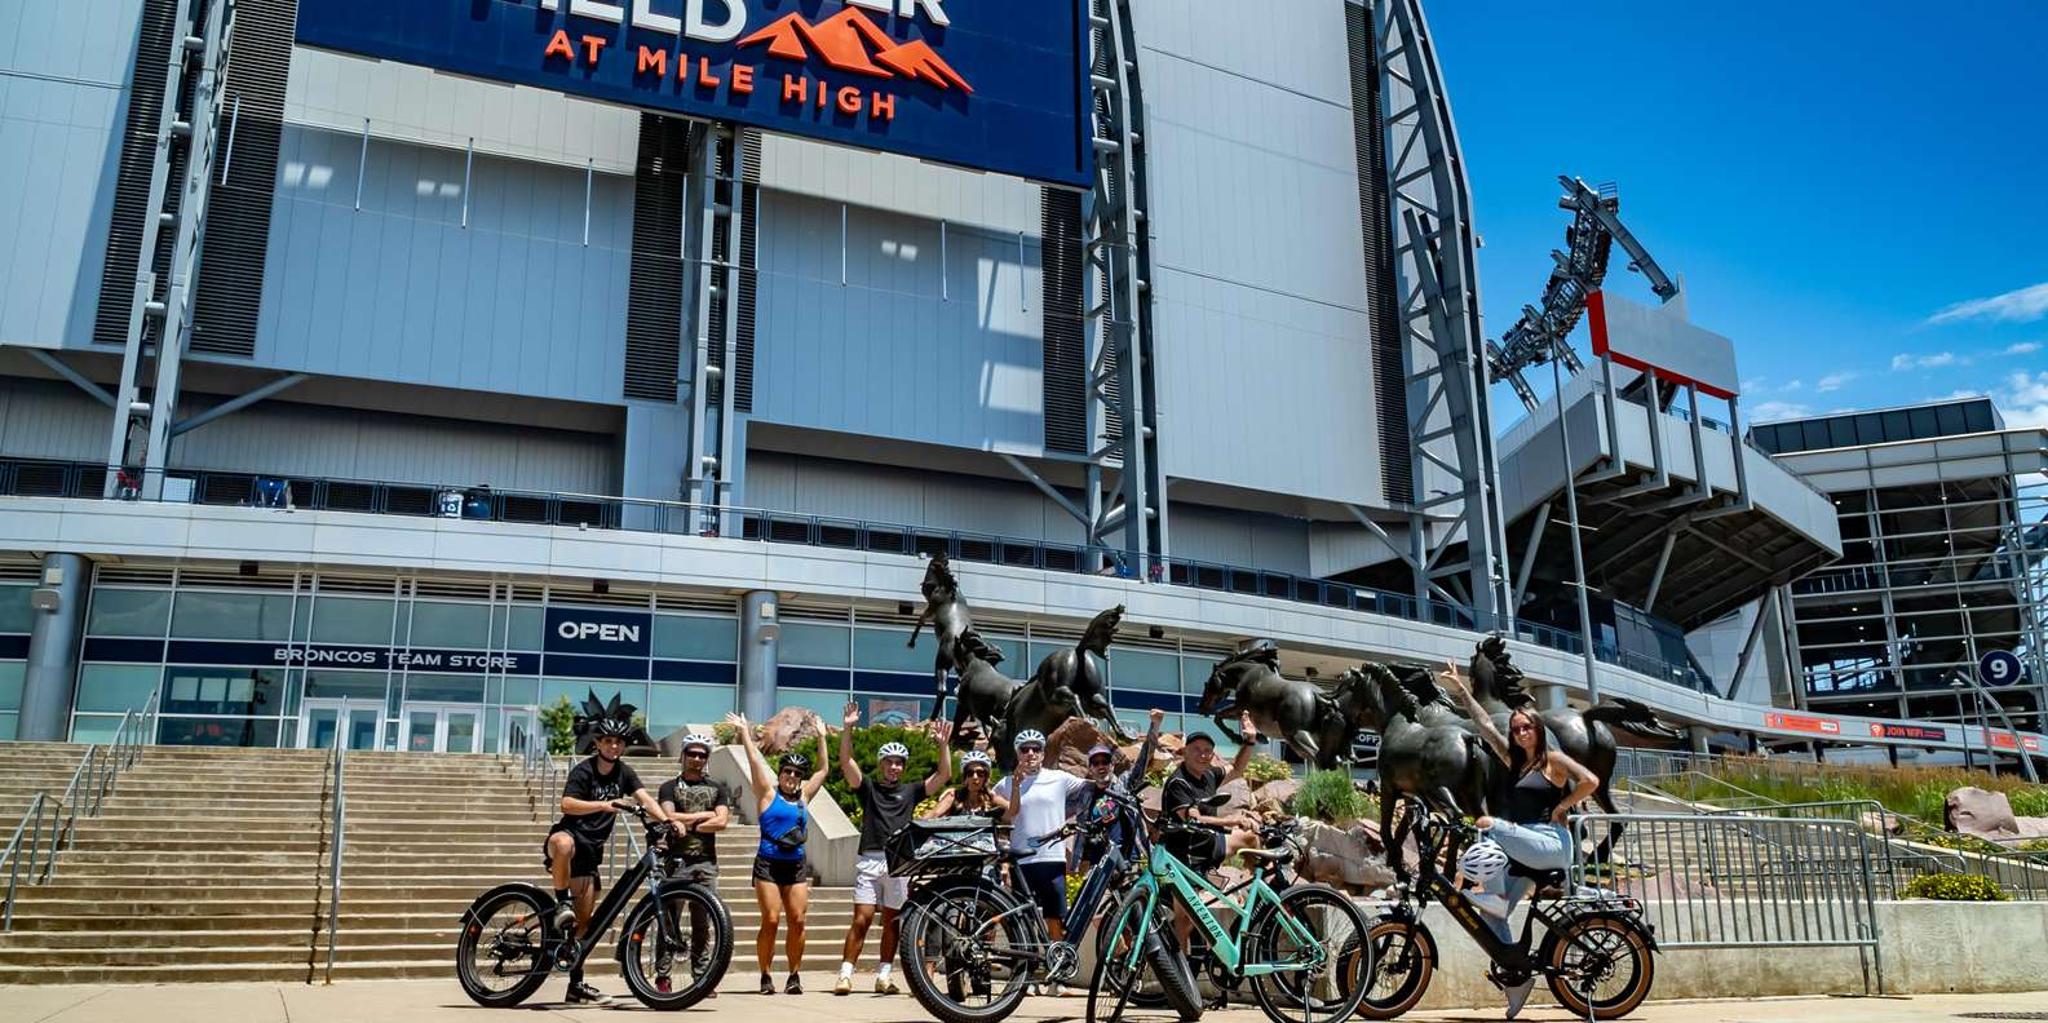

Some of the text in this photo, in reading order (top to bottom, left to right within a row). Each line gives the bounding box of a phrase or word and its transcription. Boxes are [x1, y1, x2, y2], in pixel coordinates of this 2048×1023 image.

[545, 29, 895, 120] AT MILE HIGH
[558, 621, 640, 642] OPEN
[274, 648, 518, 669] BRONCOS TEAM STORE
[1990, 659, 2008, 679] 9
[1188, 894, 1223, 939] AVENTON
